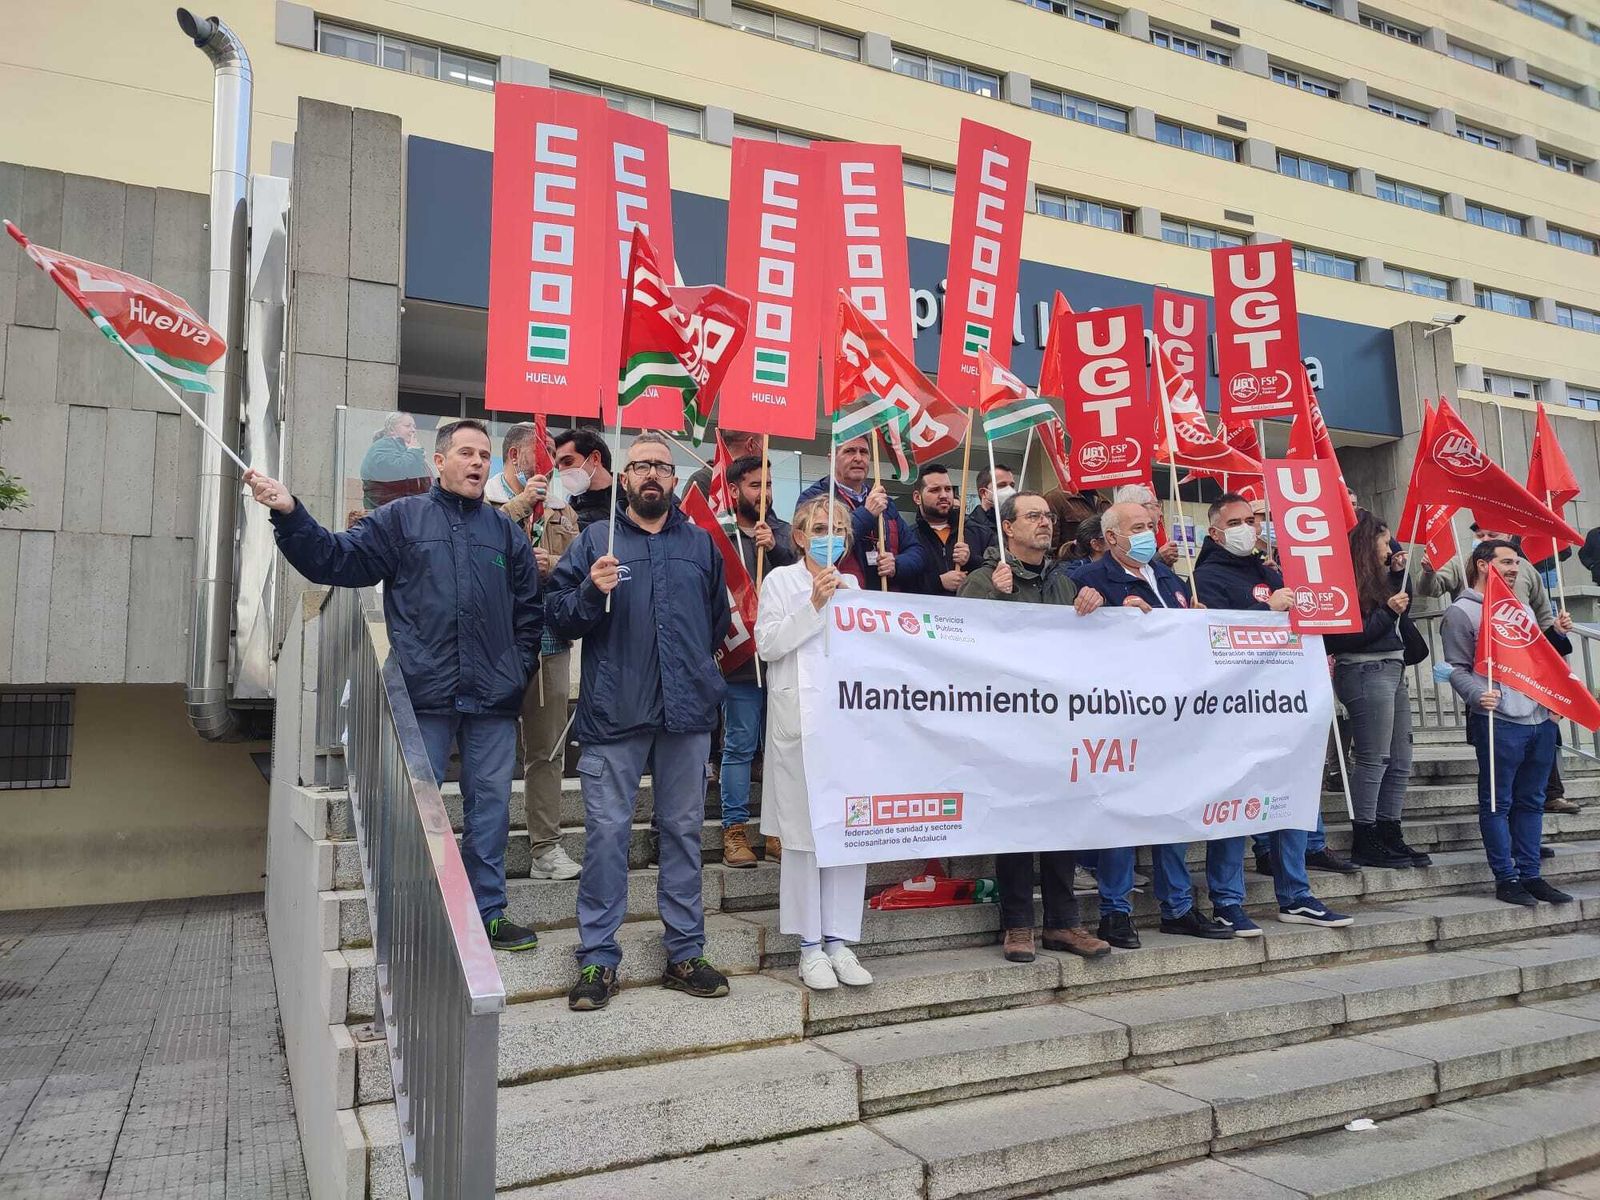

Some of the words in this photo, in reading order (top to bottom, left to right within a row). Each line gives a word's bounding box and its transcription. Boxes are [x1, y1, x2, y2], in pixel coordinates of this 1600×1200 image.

[529, 122, 578, 315] CCOO
[840, 162, 887, 320] CCOO
[967, 148, 1009, 318] CCOO
[755, 169, 799, 342] CCOO
[129, 297, 212, 346] Huelva
[1228, 251, 1282, 369] UGT
[525, 371, 568, 385] HUELVA
[1076, 316, 1132, 438] UGT
[1233, 377, 1255, 389] UGT
[1261, 376, 1278, 386] FSP
[751, 392, 787, 407] HUELVA
[1083, 446, 1105, 459] UGT
[1111, 444, 1128, 454] FSP
[1276, 467, 1334, 584] UGT
[1296, 591, 1313, 605] UGT
[1318, 592, 1334, 602] FSP
[834, 606, 892, 633] UGT
[934, 615, 964, 624] Servicios
[1233, 630, 1289, 645] CCOO
[838, 680, 1059, 715] Mantenimiento
[1068, 687, 1167, 721] público
[1173, 695, 1188, 722] y
[1193, 690, 1218, 715] de
[1222, 689, 1309, 714] calidad
[1070, 738, 1139, 783] ¡YA!
[878, 799, 940, 819] CCOO
[1202, 799, 1242, 825] UGT
[844, 828, 884, 837] federación
[885, 826, 894, 834] de
[896, 825, 922, 833] sanidad
[931, 823, 962, 831] sectores
[844, 837, 900, 848] sociosanitarios
[902, 836, 911, 844] de
[912, 834, 947, 843] Andalucía
